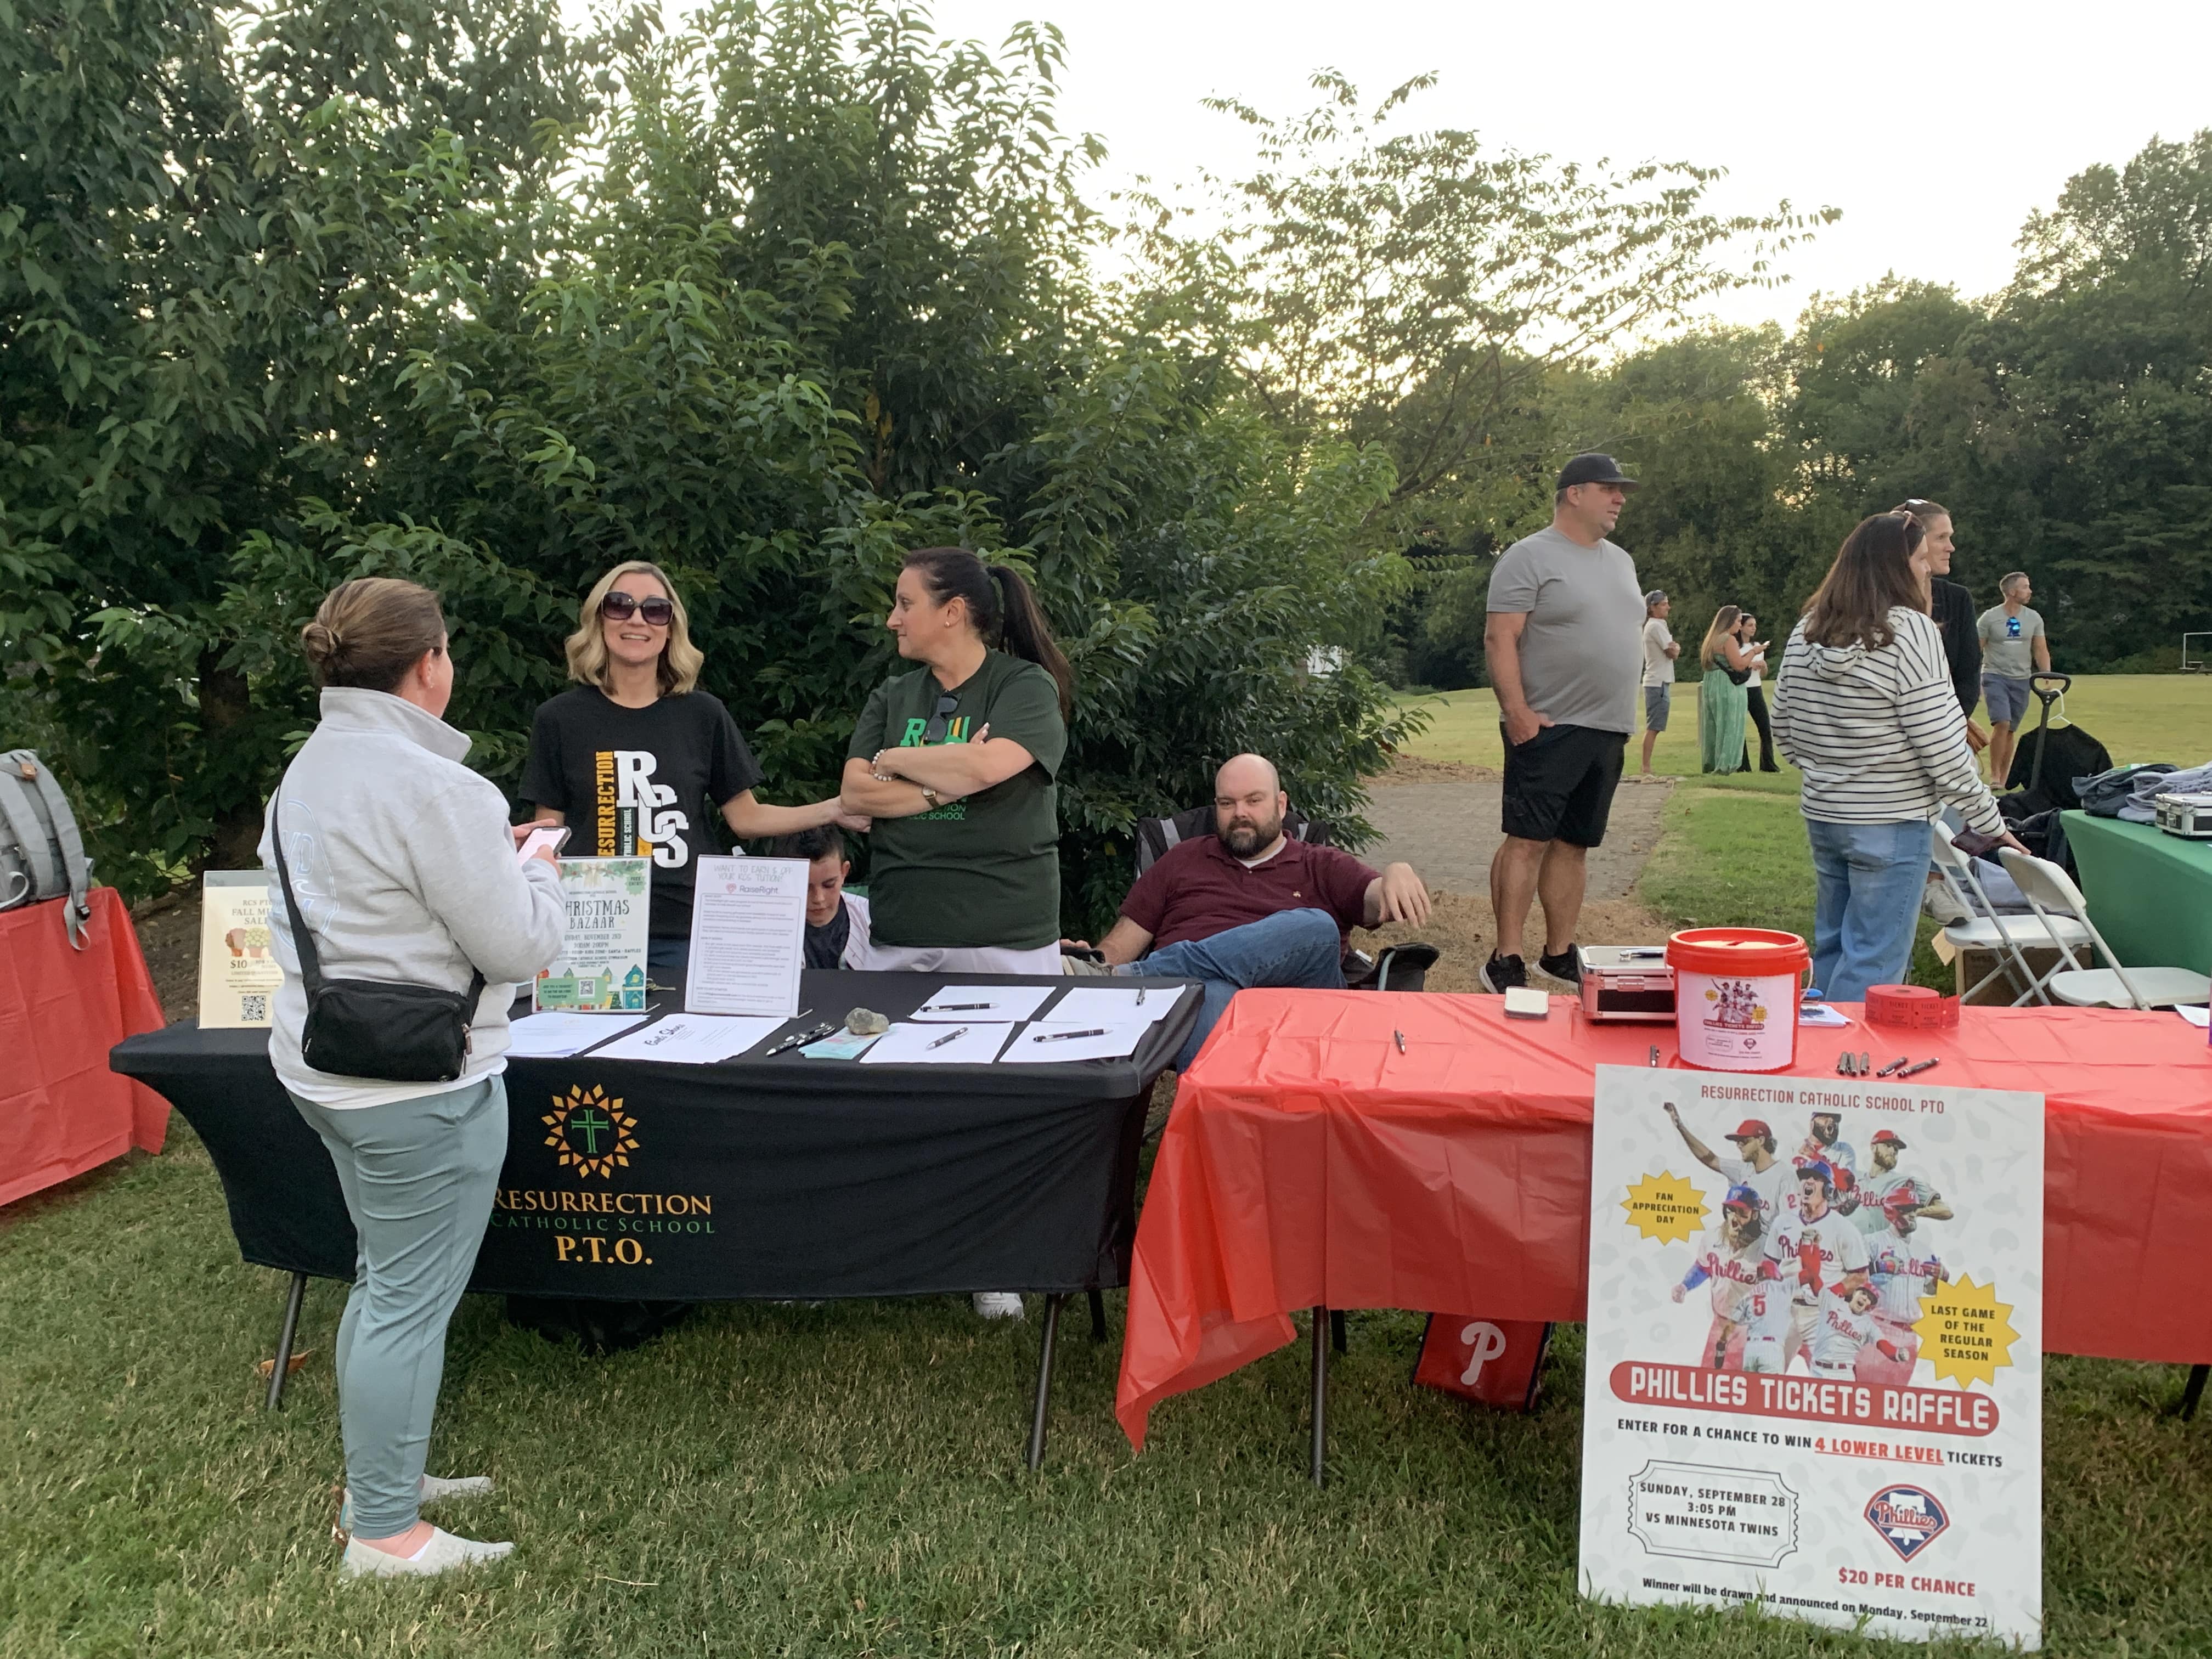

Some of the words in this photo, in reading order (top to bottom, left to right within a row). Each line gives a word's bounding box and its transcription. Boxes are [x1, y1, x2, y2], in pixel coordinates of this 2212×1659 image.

[595, 751, 616, 856] ESURRECTION
[929, 812, 966, 821] SCHOOL
[739, 885, 778, 895] RaiseRight
[566, 899, 630, 917] HRISTMAS
[569, 916, 615, 929] BAZAAR
[230, 960, 247, 969] $10
[1701, 1085, 1794, 1104] RESURRECTION
[1799, 1091, 1860, 1108] CATHOLIC
[1866, 1096, 1915, 1113] SCHOOL
[1921, 1099, 1944, 1114] PTO
[1655, 1192, 1673, 1201] FAN
[1632, 1201, 1699, 1215] APPRECIATION
[618, 1217, 715, 1234] SCHOOL
[1656, 1215, 1674, 1224] DAY
[554, 1235, 653, 1265] P.T.O.
[1753, 1294, 1767, 1317] 5
[1931, 1305, 1958, 1316] LAST
[1962, 1307, 1996, 1319] GAME
[1825, 1310, 1863, 1342] Phillies
[1944, 1320, 1959, 1330] OF
[1963, 1322, 1985, 1333] THE
[1940, 1334, 1993, 1347] REGULAR
[1460, 1321, 1506, 1385] P
[1944, 1348, 1989, 1361] SEASON
[1630, 1365, 1747, 1407] PHILLIES
[1759, 1378, 1871, 1418] TICKETS
[1883, 1389, 1989, 1430] RAFFLE
[1618, 1418, 1658, 1433] ENTER
[1663, 1422, 1688, 1436] FOR
[1693, 1426, 1702, 1437] A
[1706, 1427, 1758, 1443] CHANCE
[1762, 1432, 1780, 1444] TO
[1785, 1435, 1812, 1448] WIN
[1815, 1437, 1826, 1451] 4
[1832, 1438, 1889, 1458] LOWER
[1895, 1444, 1944, 1463] LEVEL
[1947, 1451, 2003, 1468] TICKETS
[1640, 1482, 1694, 1498] SUNDAY,
[1697, 1488, 1767, 1505] SEPTEMBER
[1771, 1496, 1786, 1507] 28
[1687, 1502, 1714, 1515] 3:05
[1718, 1505, 1737, 1517] PM
[1873, 1500, 1938, 1532] Phillies
[1645, 1512, 1661, 1523] VS
[1664, 1514, 1735, 1532] MINNESOTA
[1740, 1522, 1779, 1536] TWINS
[1838, 1566, 1869, 1585] $20
[1874, 1572, 1905, 1589] PER
[1911, 1576, 1976, 1597] CHANCE
[1642, 1577, 1680, 1592] Winner
[1682, 1582, 1701, 1595] will
[1703, 1585, 1717, 1596] be
[1720, 1587, 1753, 1600] drawn
[1779, 1595, 1838, 1610] announced
[1842, 1603, 1856, 1613] on
[1859, 1604, 1908, 1620] Monday,
[1910, 1610, 1972, 1627] September
[1974, 1616, 1988, 1628] 22
